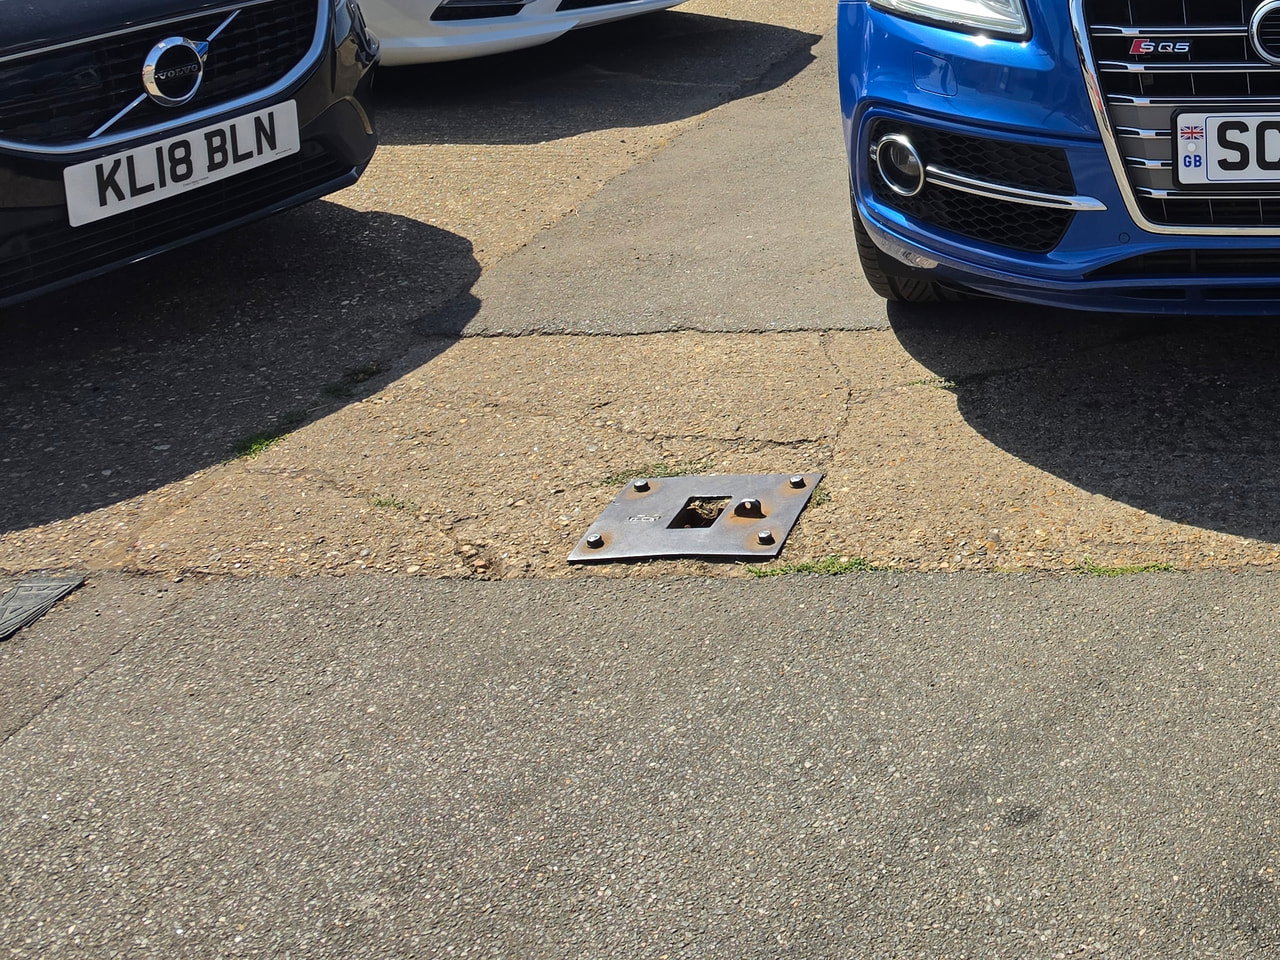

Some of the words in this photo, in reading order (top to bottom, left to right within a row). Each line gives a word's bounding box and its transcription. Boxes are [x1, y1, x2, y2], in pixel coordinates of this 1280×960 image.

[1138, 41, 1191, 53] SQ5
[156, 63, 199, 80] VOLVO
[94, 138, 194, 208] KL18
[203, 111, 278, 174] BLN
[1183, 154, 1203, 169] GB
